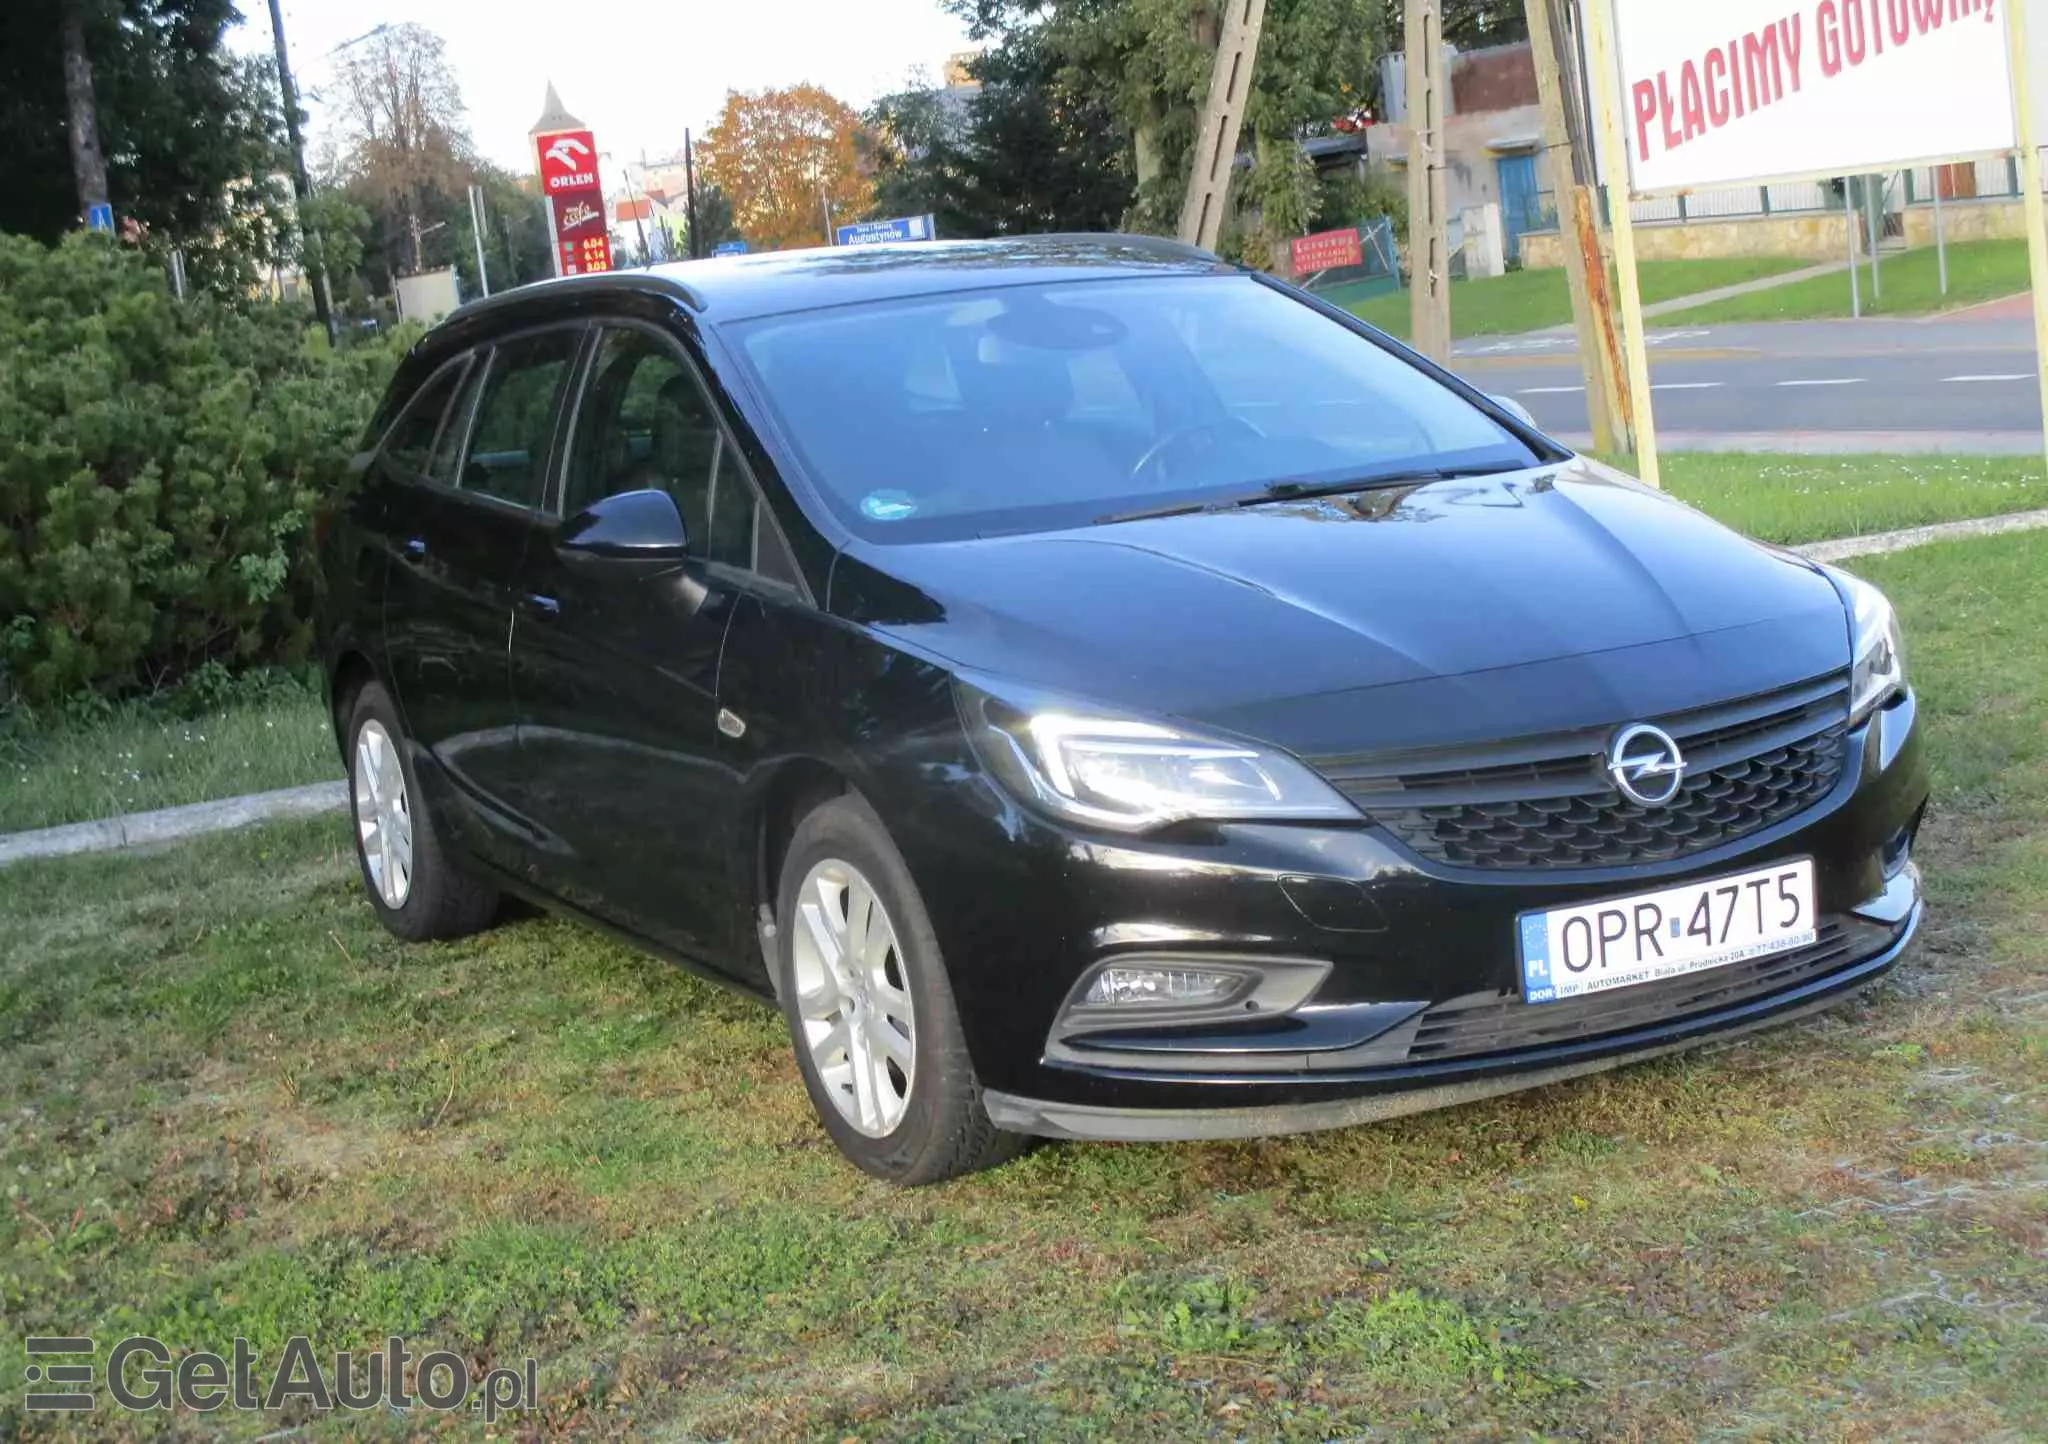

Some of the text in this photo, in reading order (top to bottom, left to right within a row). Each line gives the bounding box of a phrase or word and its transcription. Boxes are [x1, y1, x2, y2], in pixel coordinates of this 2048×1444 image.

[1632, 12, 1801, 161] PŁACIMY
[550, 172, 593, 188] ORLEN
[1562, 871, 1800, 973] OPR 47T5
[1528, 959, 1549, 978] PL
[1587, 970, 1649, 991] AUTOMARKET
